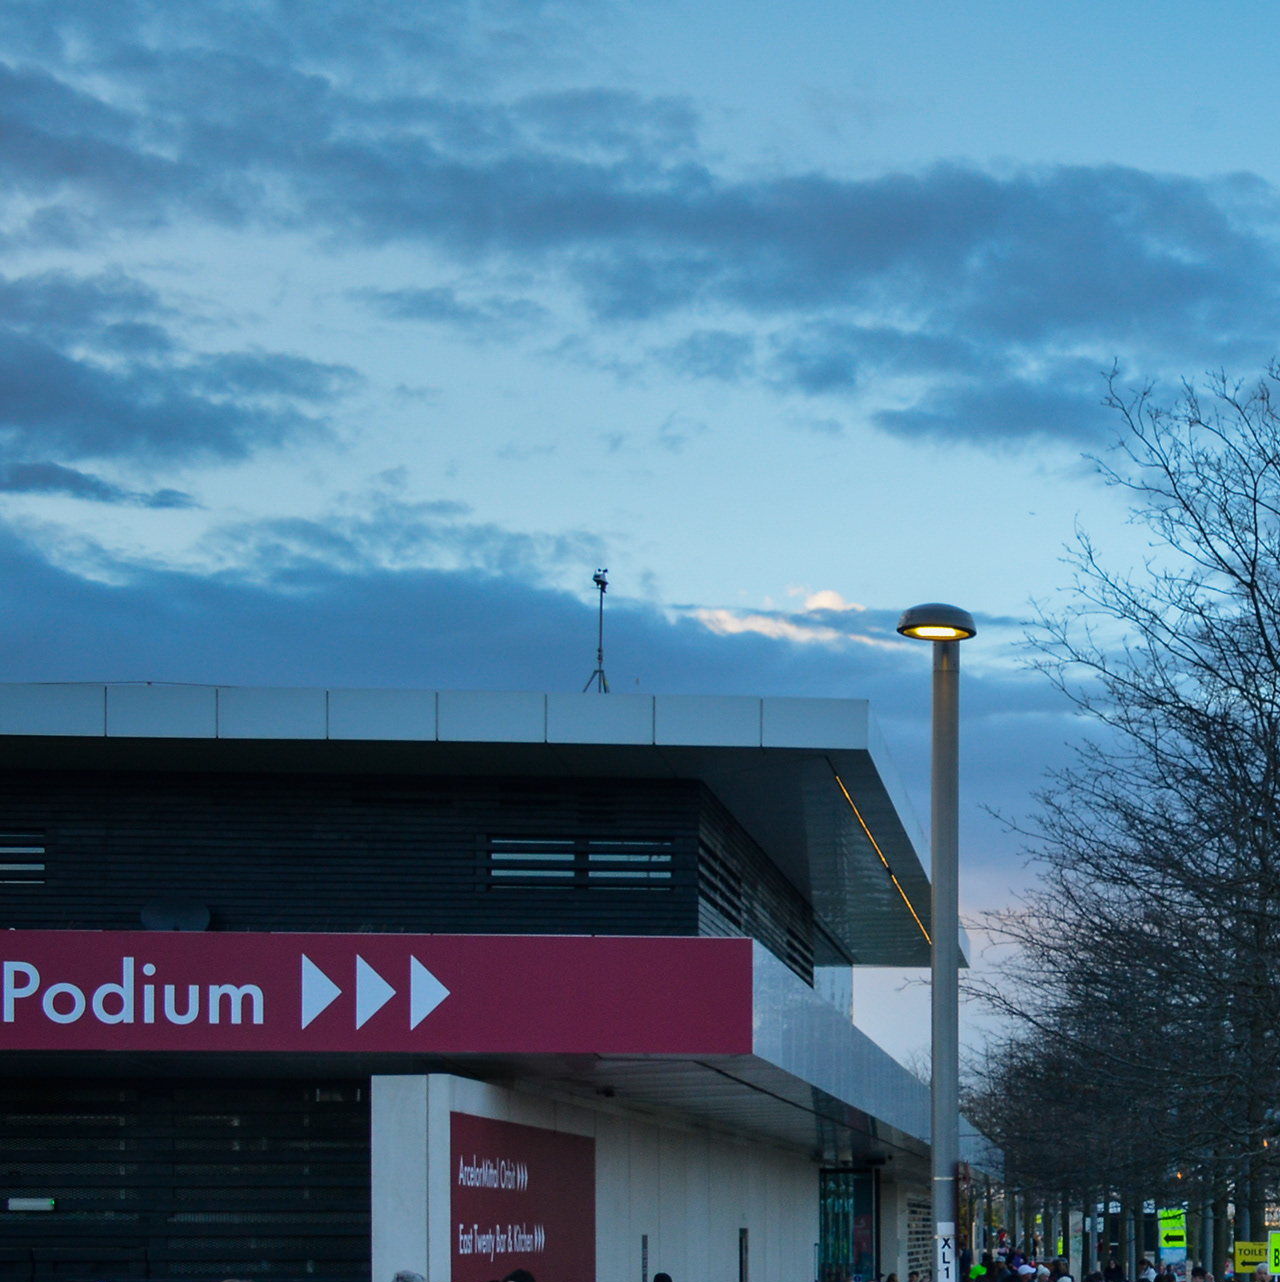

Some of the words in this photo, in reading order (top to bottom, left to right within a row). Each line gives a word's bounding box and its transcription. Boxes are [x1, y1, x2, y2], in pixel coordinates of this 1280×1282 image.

[2, 956, 264, 1026] Podium
[459, 1154, 499, 1188] ArcelorMittal
[501, 1159, 516, 1190] Orbit
[459, 1224, 473, 1255] East
[474, 1224, 495, 1262] Twenty
[496, 1224, 507, 1253] Bar
[514, 1223, 534, 1252] Kitchen
